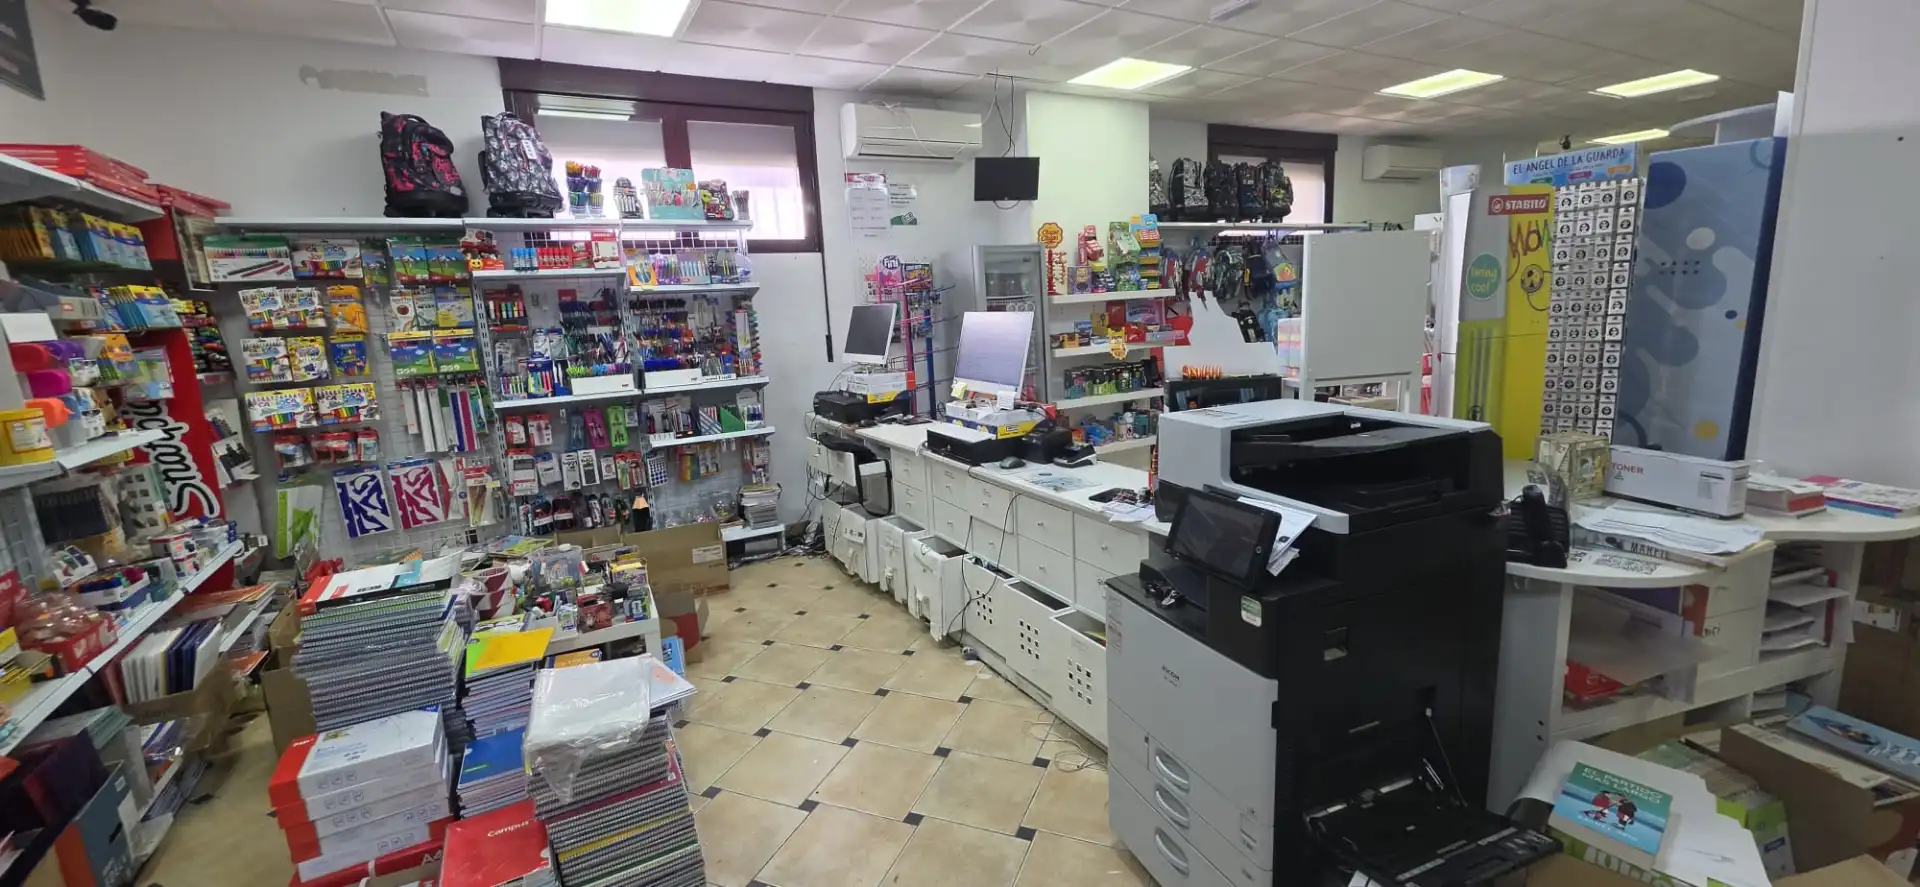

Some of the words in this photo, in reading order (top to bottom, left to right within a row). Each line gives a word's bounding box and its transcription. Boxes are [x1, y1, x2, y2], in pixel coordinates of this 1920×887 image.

[1513, 164, 1522, 175] EL
[1557, 157, 1569, 168] DE
[1571, 154, 1583, 165] LA
[1586, 148, 1625, 163] GUARDA
[1505, 199, 1546, 210] STABILO
[1612, 462, 1644, 475] TONER
